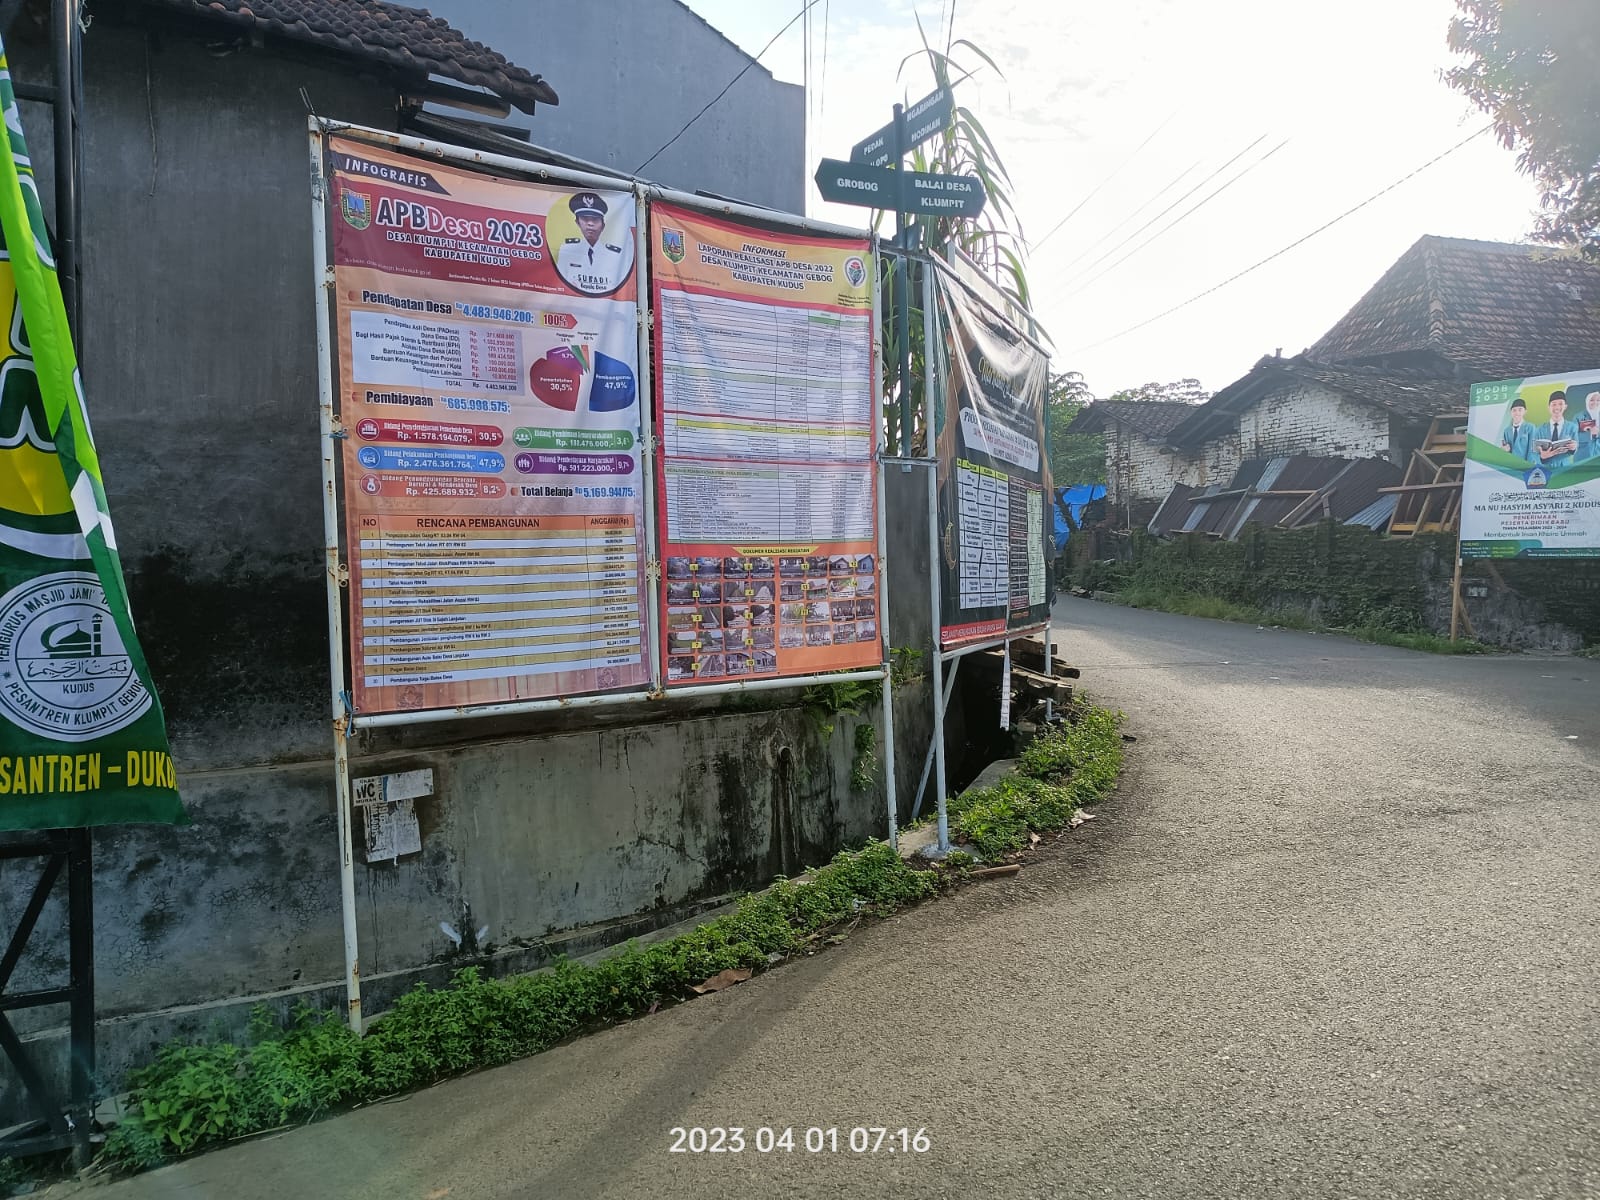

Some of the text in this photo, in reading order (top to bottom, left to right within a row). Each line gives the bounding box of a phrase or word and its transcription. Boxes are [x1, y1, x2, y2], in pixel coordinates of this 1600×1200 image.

[345, 158, 427, 187] INFOGRAFIS
[837, 178, 879, 192] GROBOG
[915, 179, 972, 192] BALAI DESA
[921, 197, 965, 209] KLUMPIT
[376, 197, 544, 248] APBDesa 2023
[387, 231, 542, 260] DESA KLUMPIT KECAMATAN GEBOG
[742, 243, 786, 258] INFORMASI
[424, 248, 511, 267] KABUPATEN KUDUS
[698, 243, 834, 273] LAPORAN REALISASI APB DESA 2022
[701, 255, 833, 282] DESA KLUMPIT KECAMATAN GEBOG
[732, 272, 776, 287] KABUPATEN
[777, 278, 805, 290] KUDUS
[362, 290, 424, 311] Pendapatan
[426, 300, 452, 314] Desa
[1476, 385, 1508, 394] PPDB
[366, 391, 433, 406] Pembiayaan
[398, 432, 411, 440] Rp.
[556, 439, 567, 447] Rp.
[479, 458, 504, 468] 47,9%
[406, 488, 420, 496] Rp.
[521, 487, 543, 496] Total
[545, 487, 573, 497] Belanja
[417, 518, 466, 527] RENCANA
[469, 518, 539, 528] PEMBANGUNAN
[24, 589, 65, 613] MASJID
[62, 682, 95, 694] KUDUS
[5, 681, 70, 725] PESANTREN
[74, 701, 118, 725] KLUMPIT
[357, 783, 375, 799] WC
